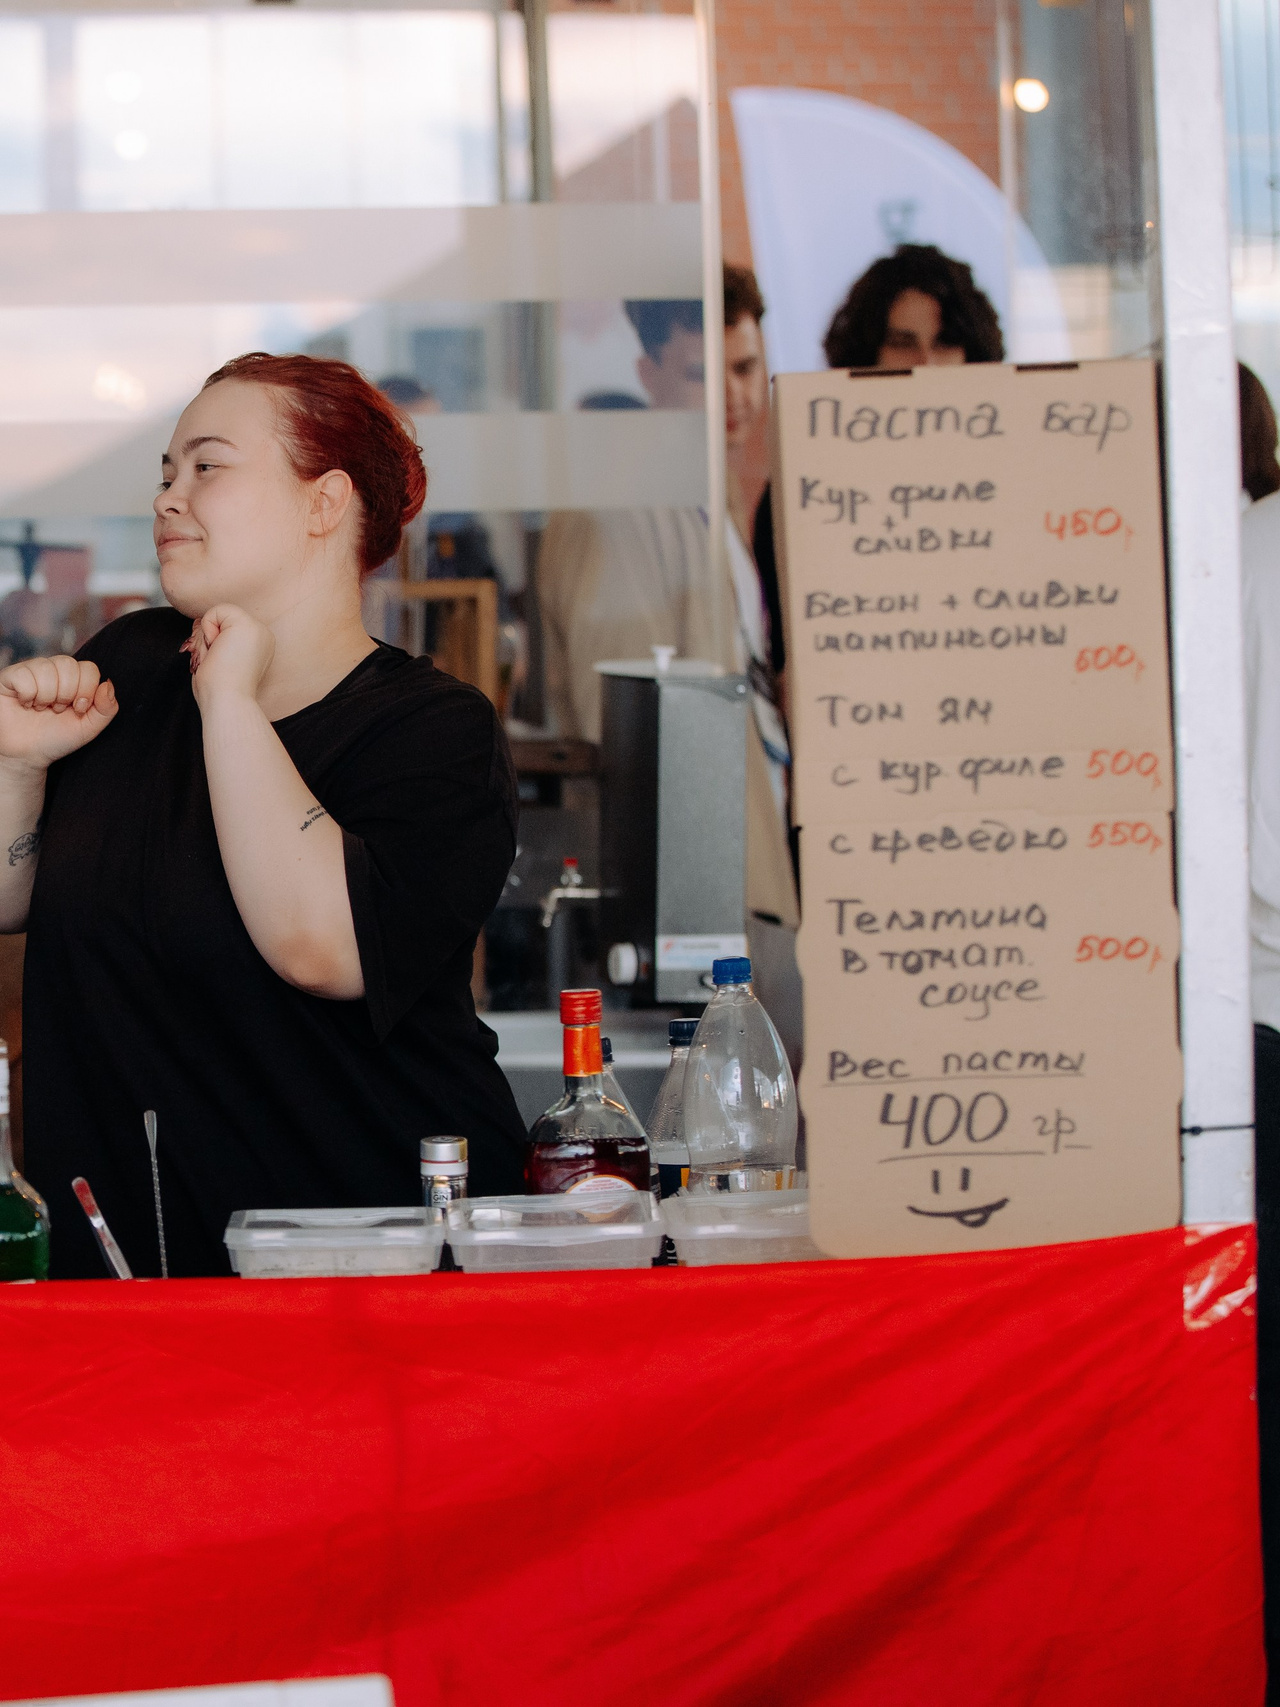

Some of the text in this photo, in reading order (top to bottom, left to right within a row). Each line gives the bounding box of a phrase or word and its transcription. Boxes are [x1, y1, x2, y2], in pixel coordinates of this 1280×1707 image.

[809, 398, 1004, 442] Паста
[889, 480, 996, 519] филе
[853, 527, 993, 555] сливки
[806, 591, 919, 618] Бекон
[973, 580, 1119, 610] сливки
[817, 695, 904, 727] Том
[832, 766, 856, 786] с
[959, 755, 1064, 793] филе
[829, 834, 853, 854] с
[826, 898, 1048, 936] Телятина
[918, 979, 1042, 1020] соусе
[827, 1049, 1085, 1083] Вес пасты
[879, 1091, 1009, 1149] 400
